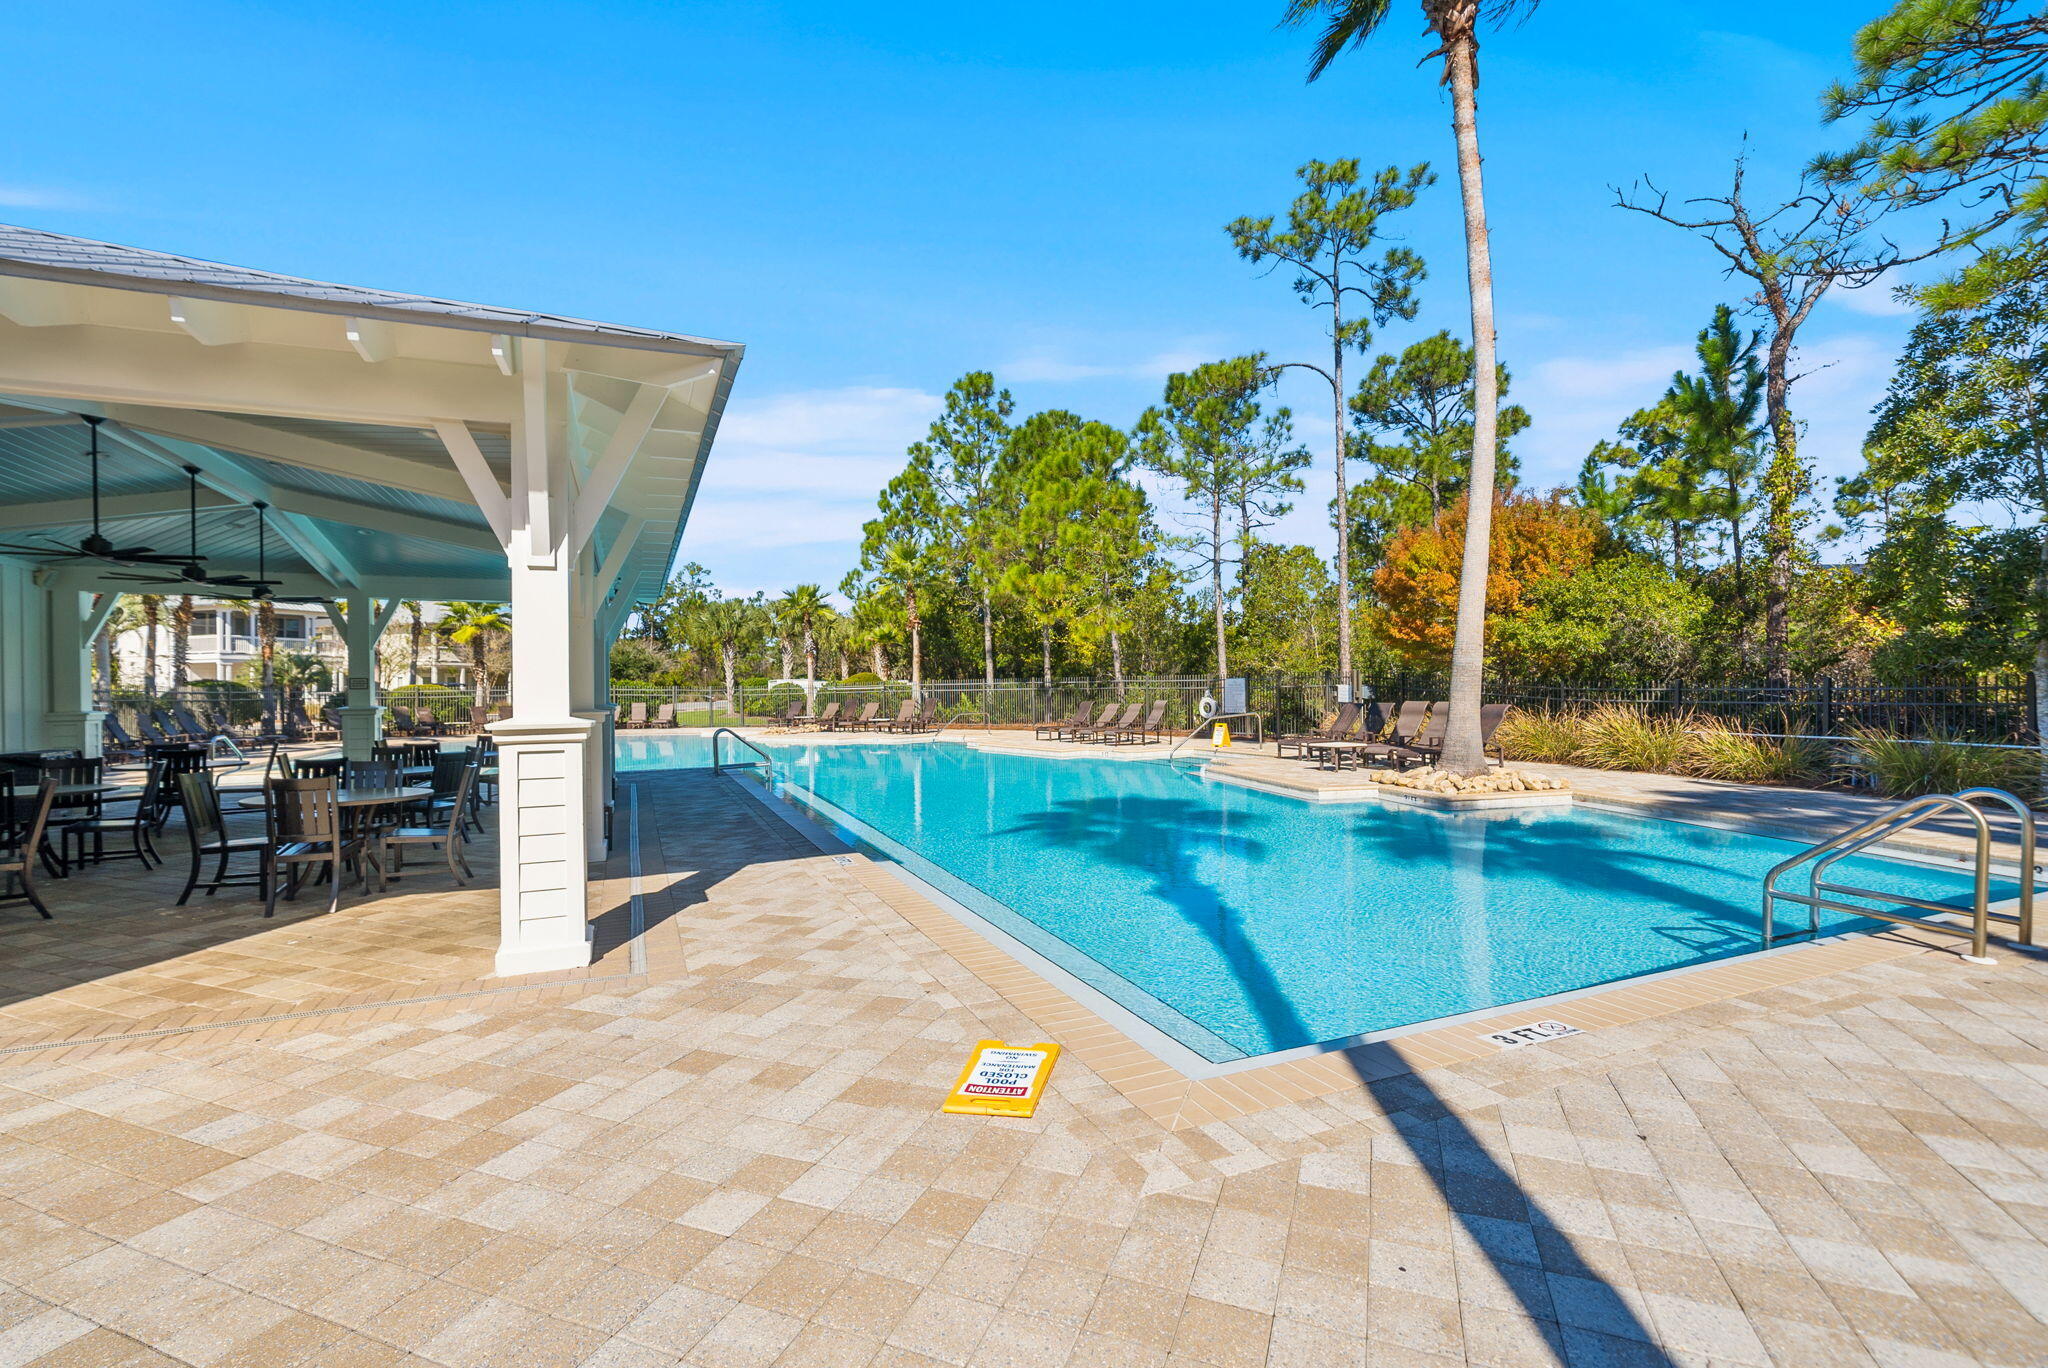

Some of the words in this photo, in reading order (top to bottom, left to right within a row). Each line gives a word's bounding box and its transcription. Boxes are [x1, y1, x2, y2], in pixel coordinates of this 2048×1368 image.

[1491, 1035, 1518, 1044] 3
[979, 1071, 1028, 1079] CLOSED
[968, 1085, 1025, 1095] ATTENTION
